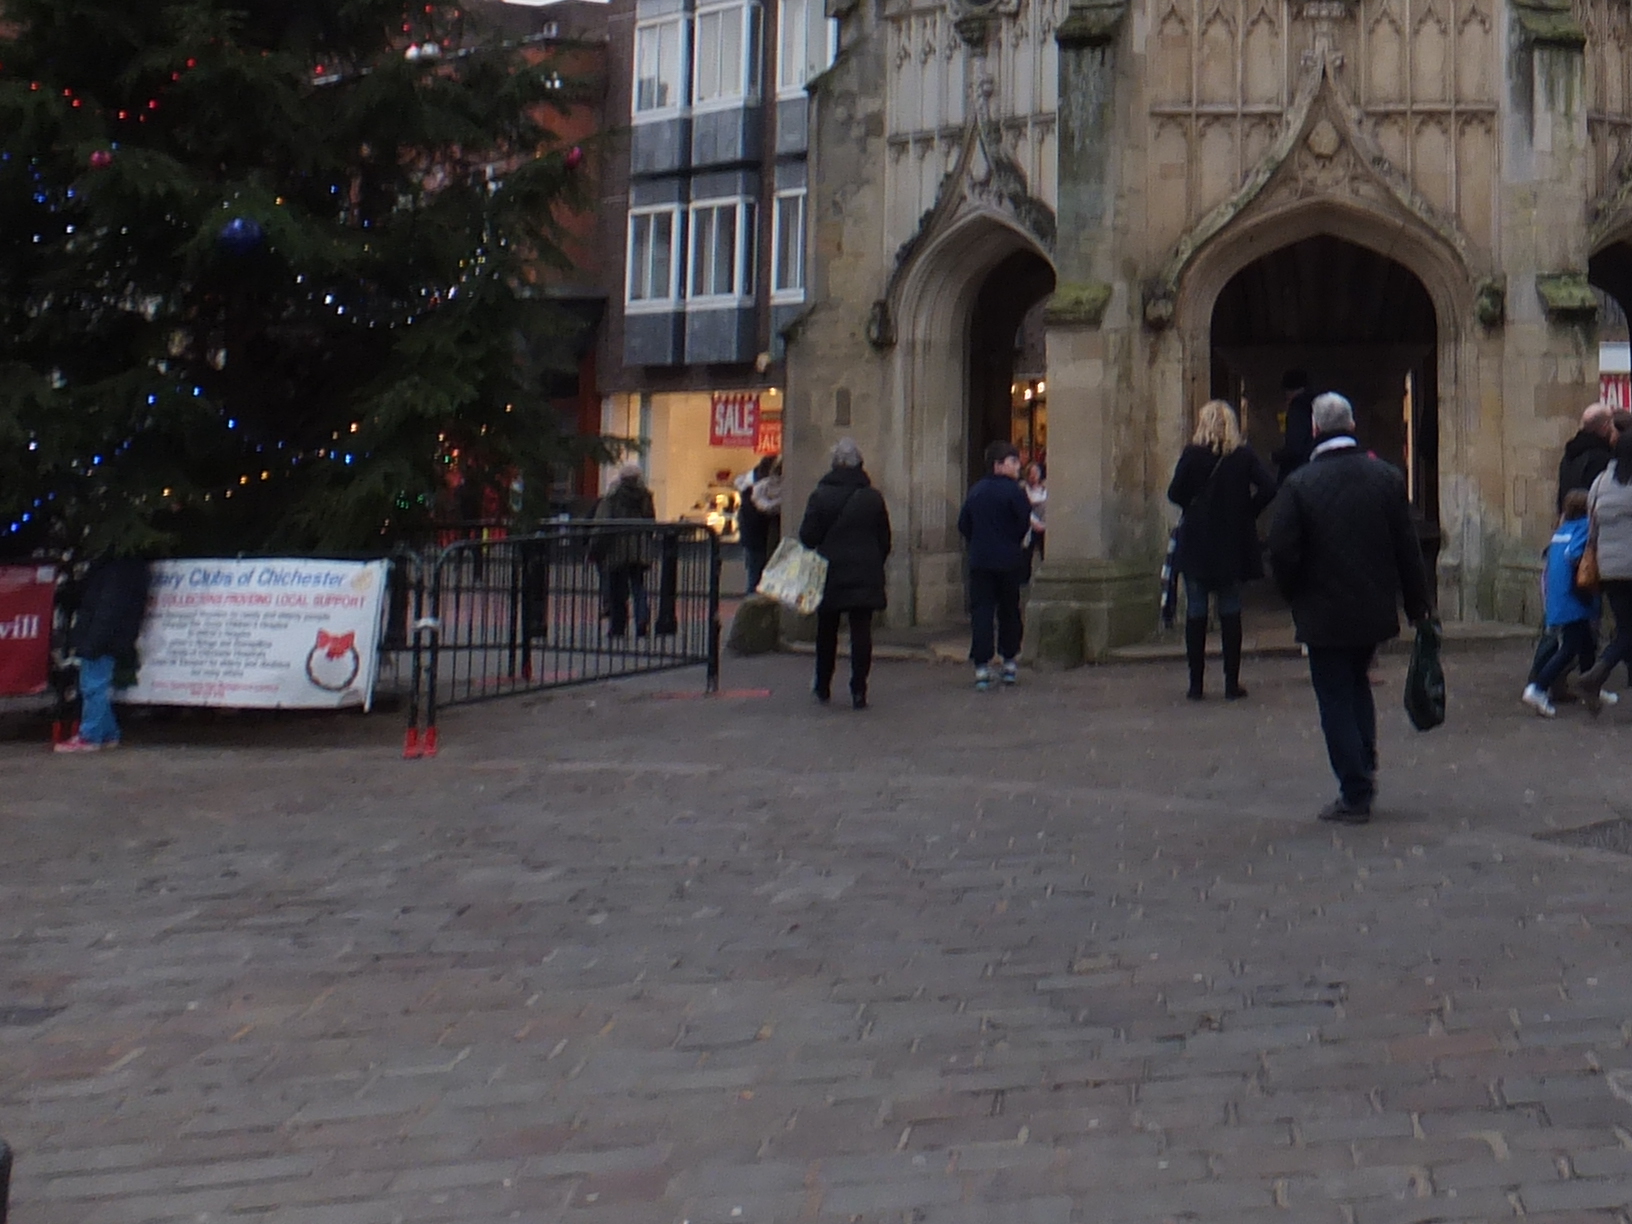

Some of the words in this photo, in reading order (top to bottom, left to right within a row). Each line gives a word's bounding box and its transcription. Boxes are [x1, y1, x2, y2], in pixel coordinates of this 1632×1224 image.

[714, 402, 754, 437] SALE
[257, 566, 345, 588] Chichester
[275, 592, 308, 608] LOCAL
[312, 592, 366, 610] SUPPORT
